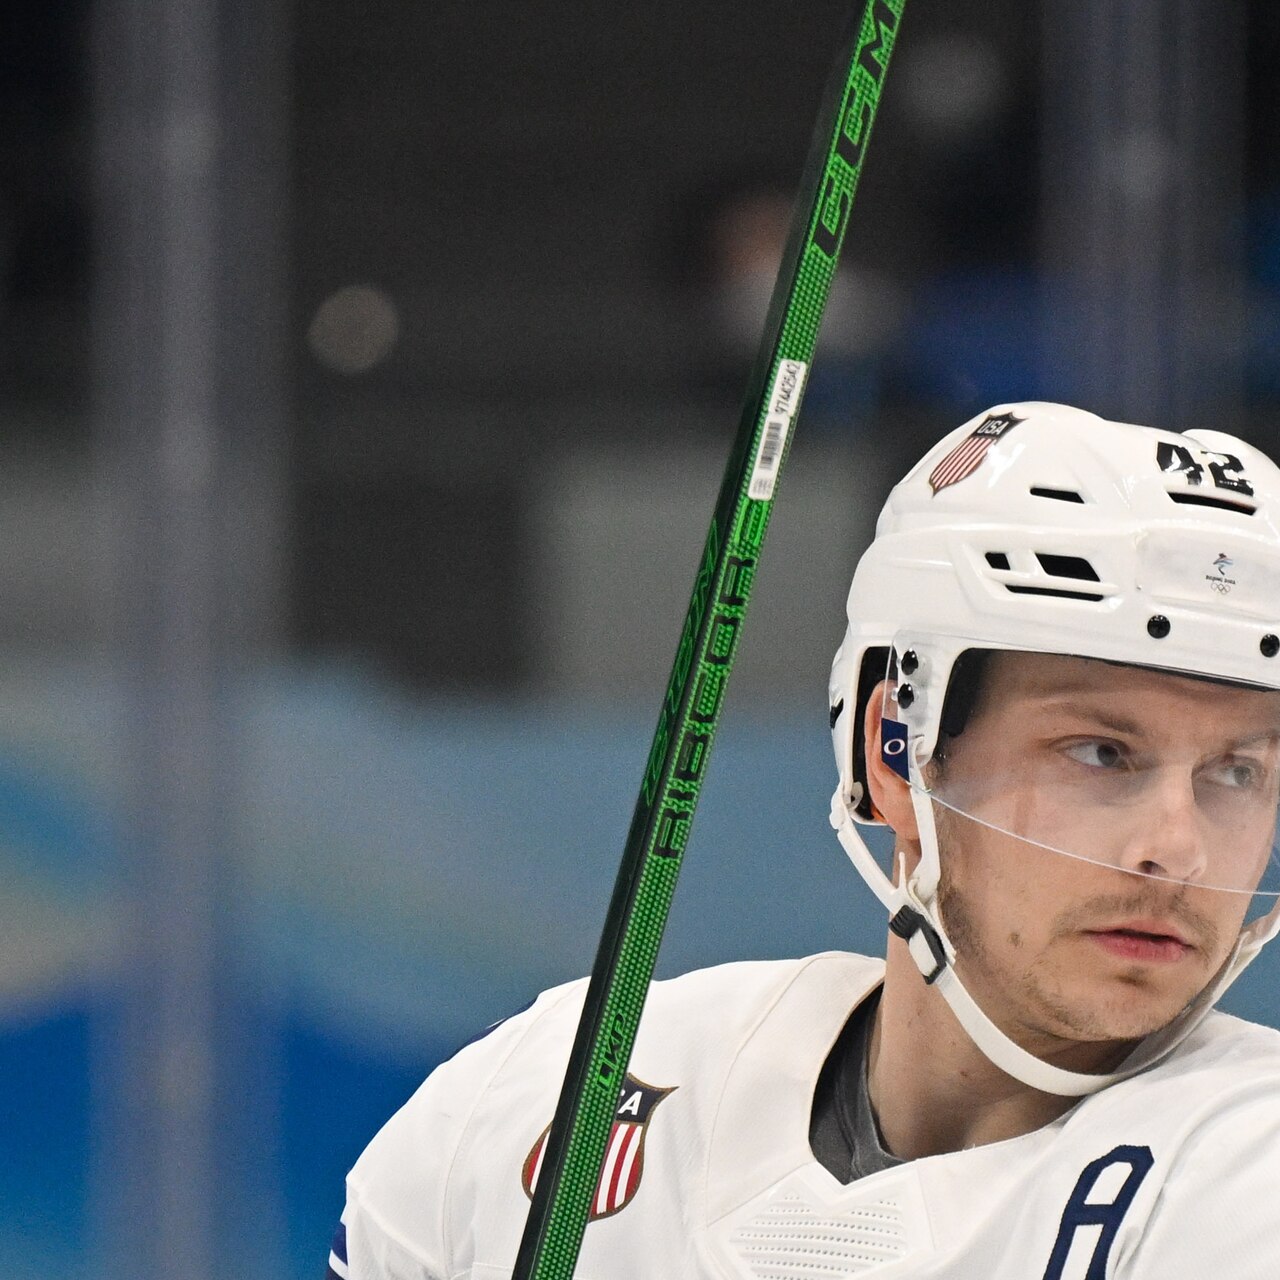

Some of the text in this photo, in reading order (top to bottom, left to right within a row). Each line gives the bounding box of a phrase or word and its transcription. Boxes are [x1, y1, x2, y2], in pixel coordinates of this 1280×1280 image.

[813, 0, 898, 258] CCM
[977, 417, 1008, 438] USA
[1156, 441, 1255, 497] 42
[652, 554, 755, 859] RIBCOR
